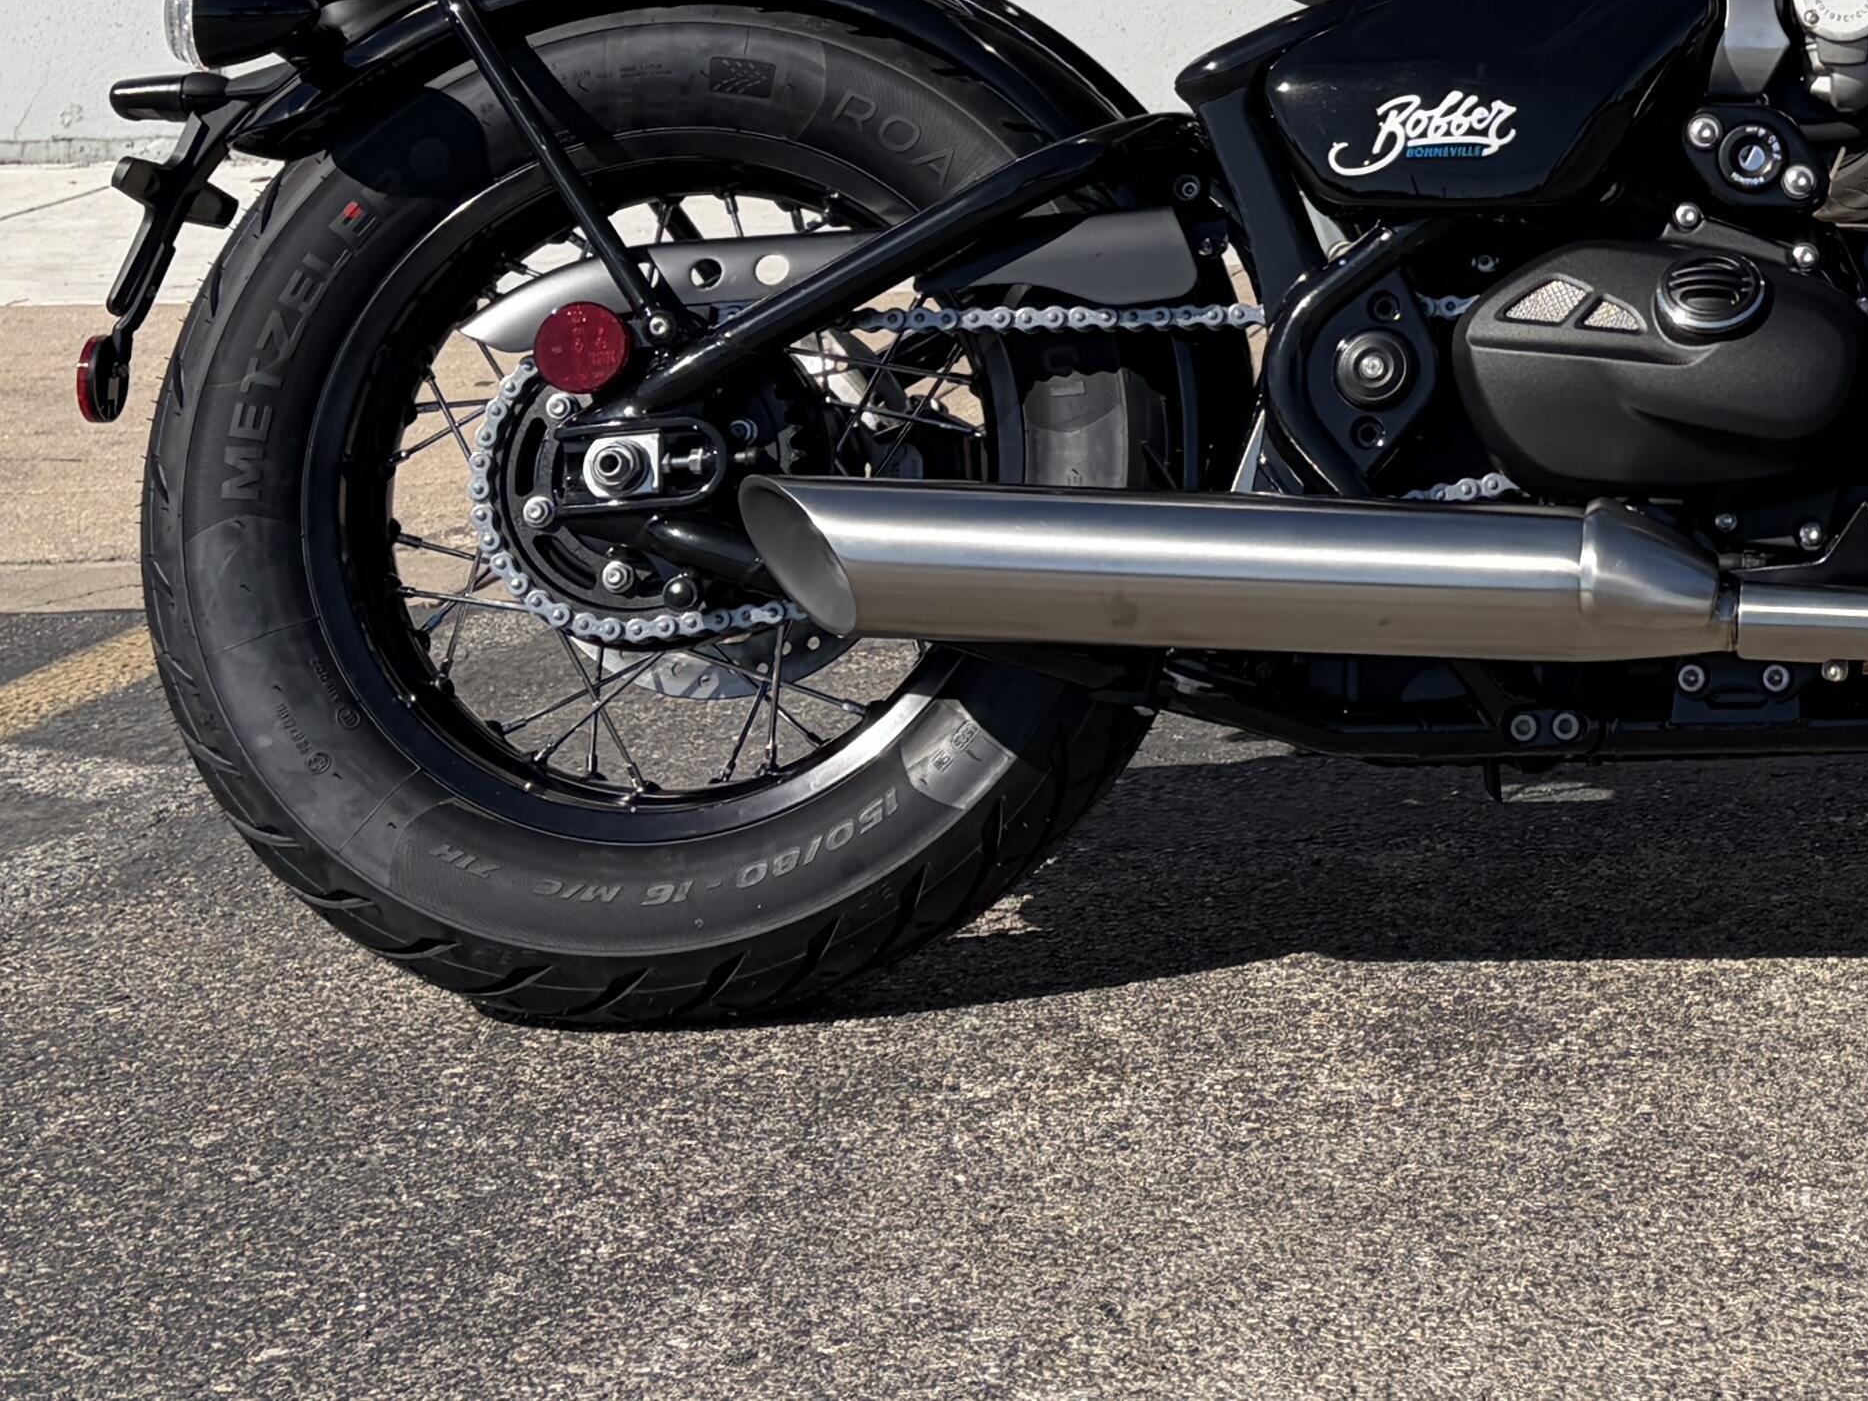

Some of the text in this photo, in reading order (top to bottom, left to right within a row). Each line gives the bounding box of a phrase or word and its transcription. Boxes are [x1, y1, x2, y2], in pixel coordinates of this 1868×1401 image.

[832, 88, 956, 189] ROA
[1327, 90, 1517, 177] Bobber
[1406, 146, 1482, 158] BONNEVILLE
